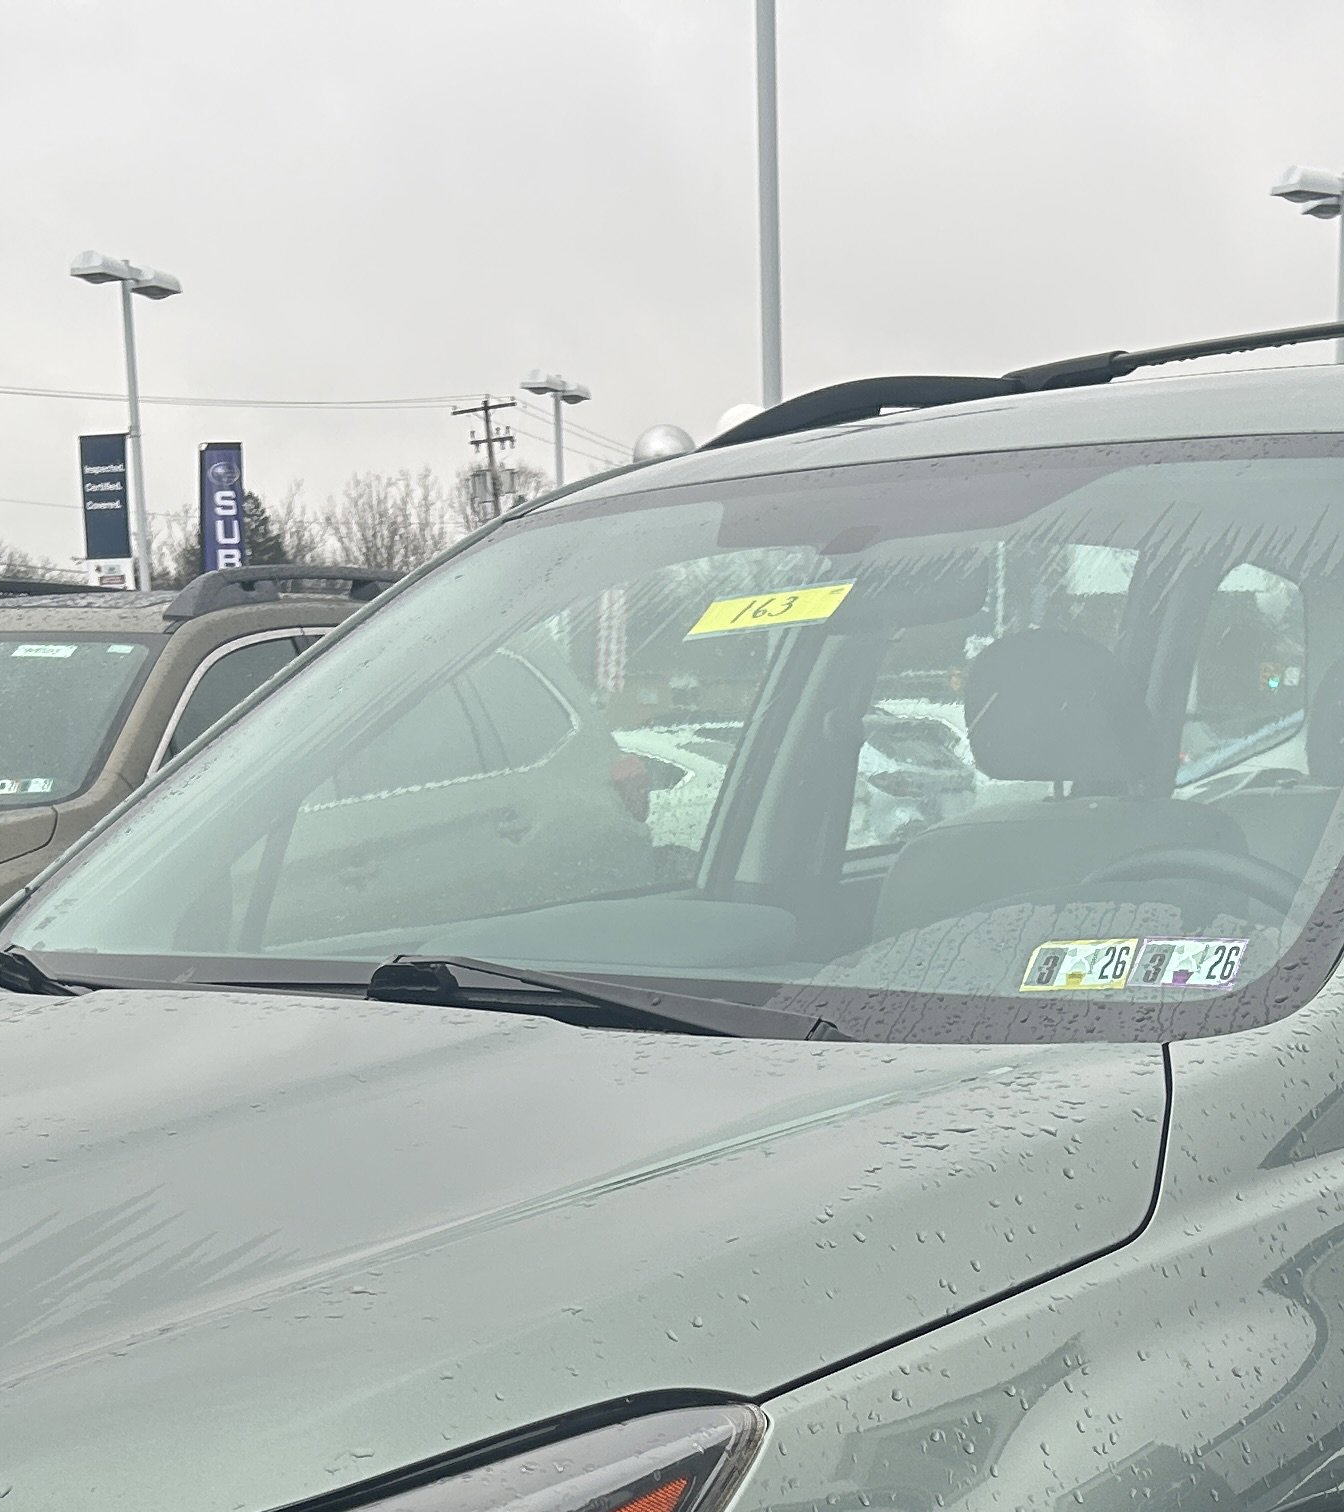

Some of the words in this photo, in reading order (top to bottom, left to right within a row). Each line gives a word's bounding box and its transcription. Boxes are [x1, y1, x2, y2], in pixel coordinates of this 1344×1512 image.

[730, 595, 799, 624] 163
[1037, 955, 1060, 984] 3
[1098, 946, 1131, 980] 26
[1143, 954, 1166, 983] 3
[1206, 945, 1240, 980] 26
